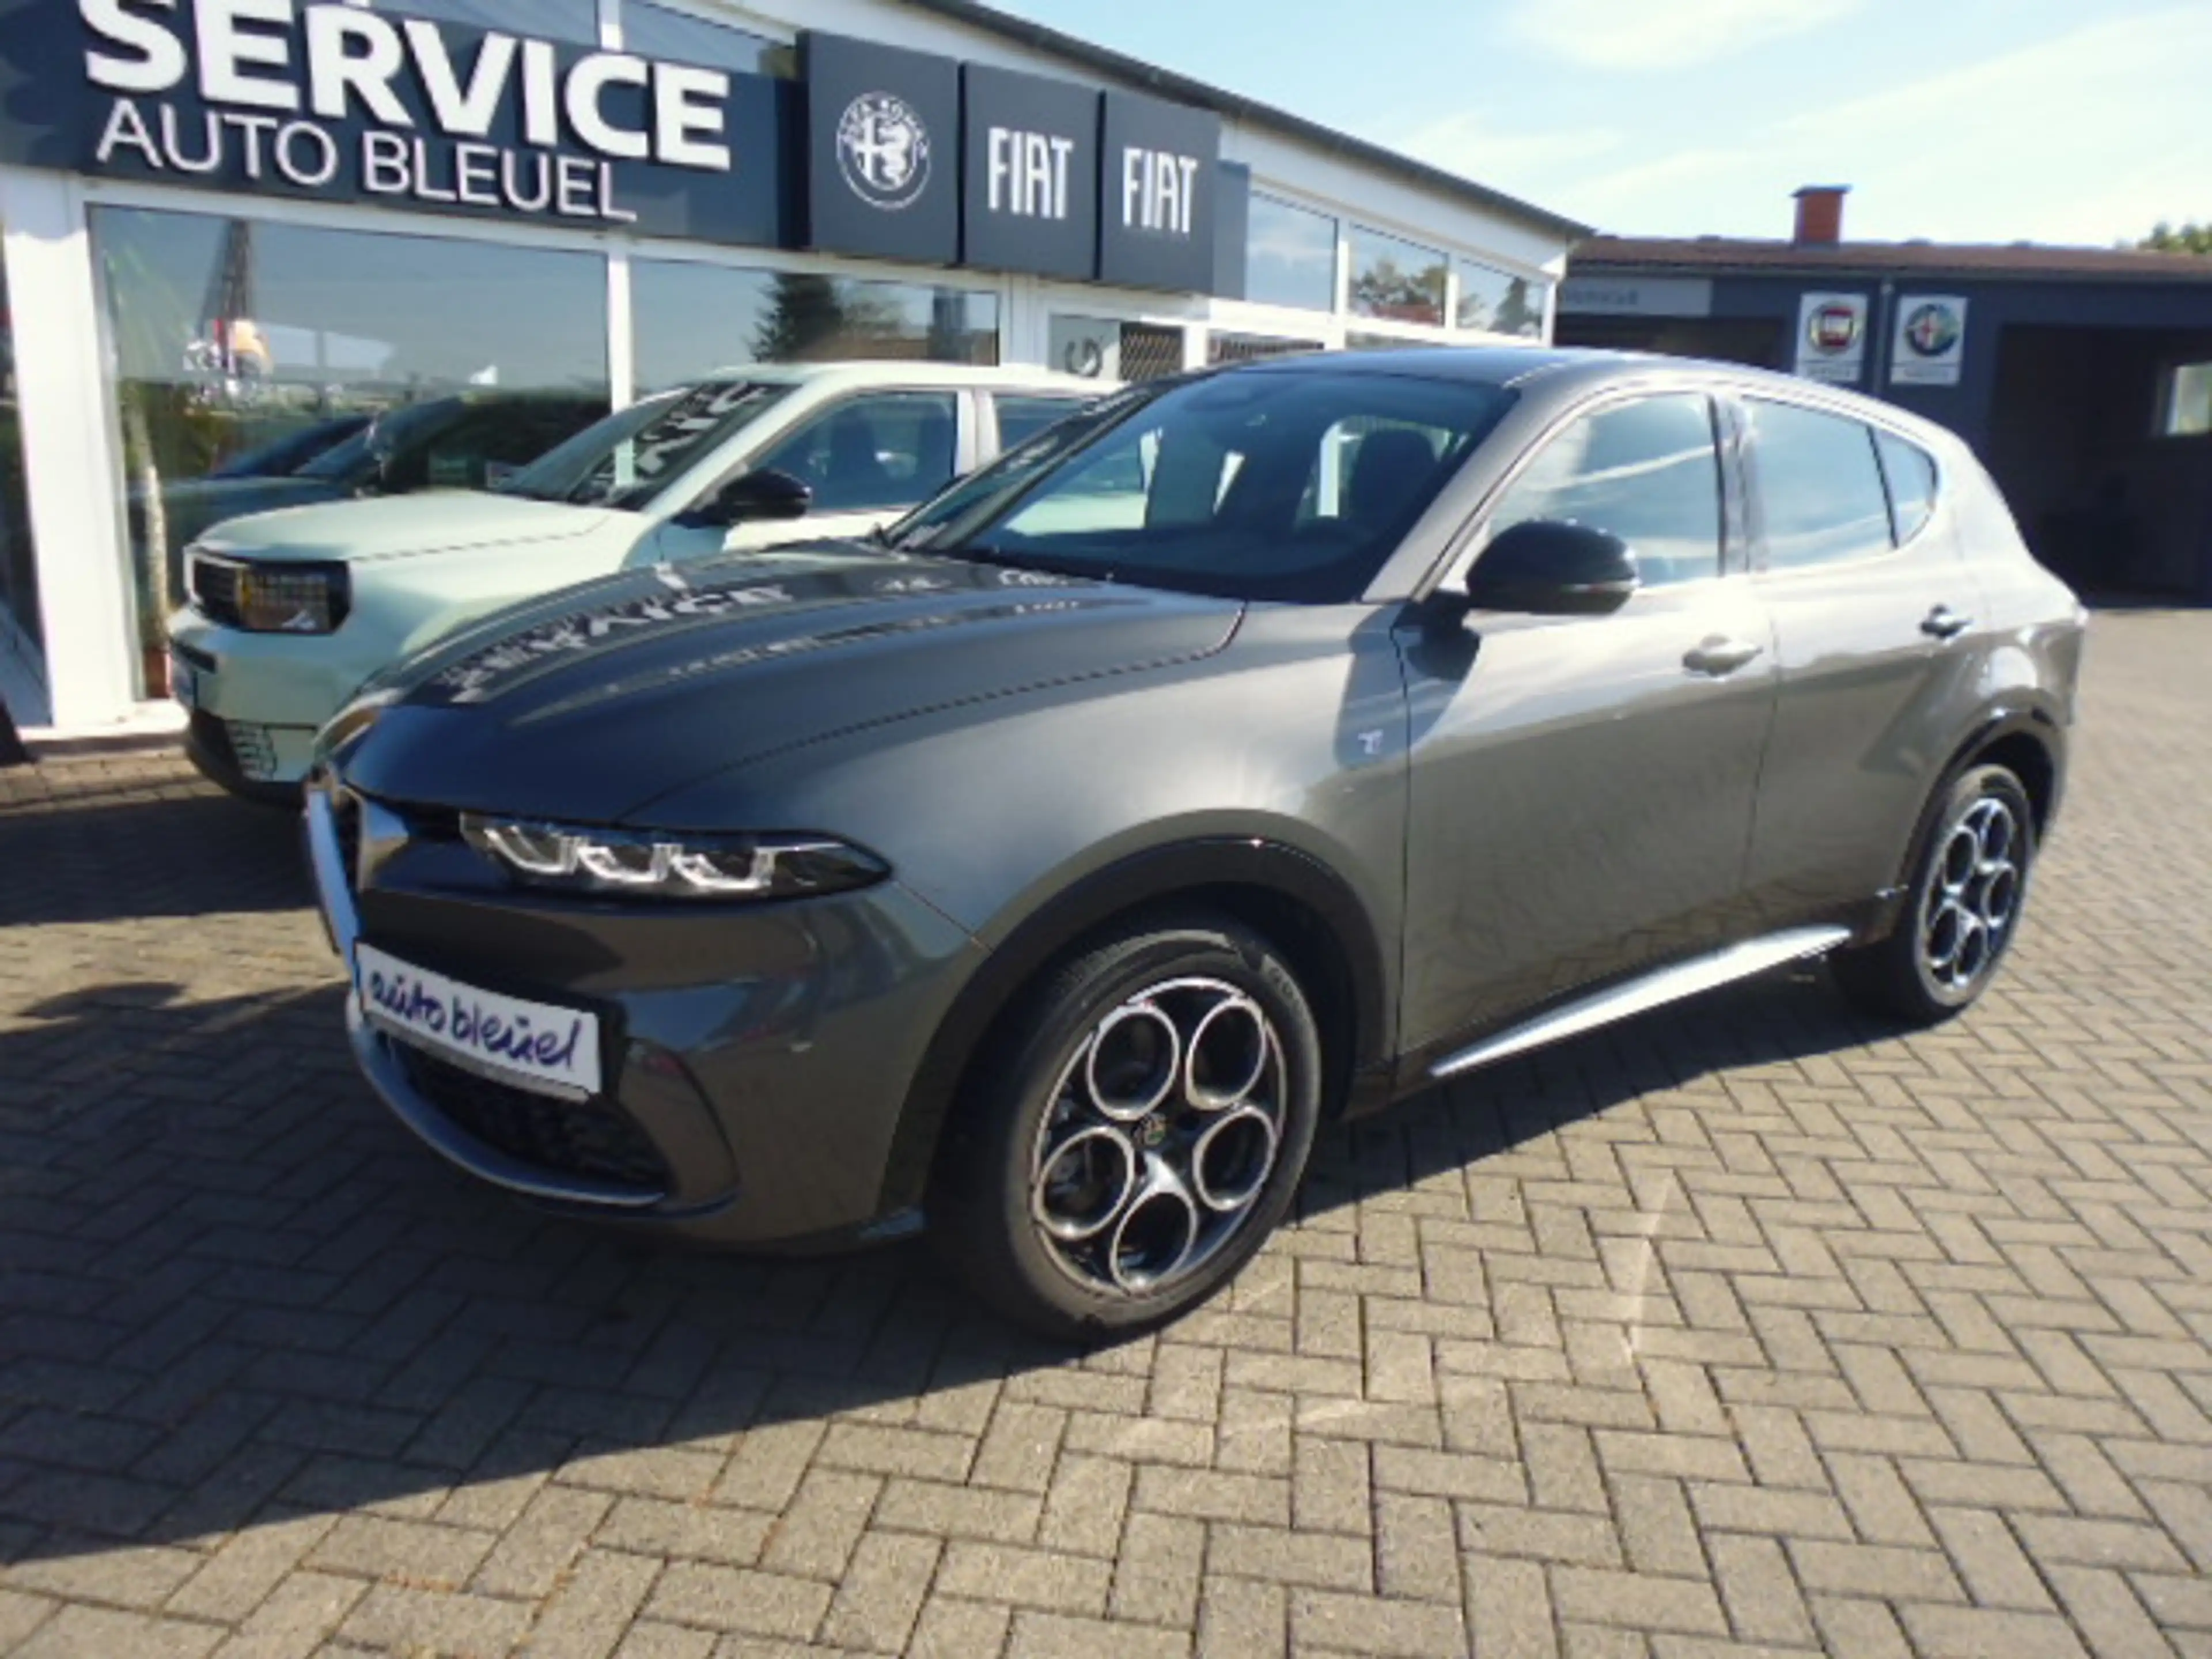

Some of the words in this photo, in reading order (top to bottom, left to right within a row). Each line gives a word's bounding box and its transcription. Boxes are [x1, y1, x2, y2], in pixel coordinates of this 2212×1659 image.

[79, 0, 730, 171] SERVICE
[96, 97, 338, 185] AUTO
[363, 130, 637, 222] BLEUEL
[988, 127, 1075, 219] FIAT
[1123, 146, 1199, 234] FIAT
